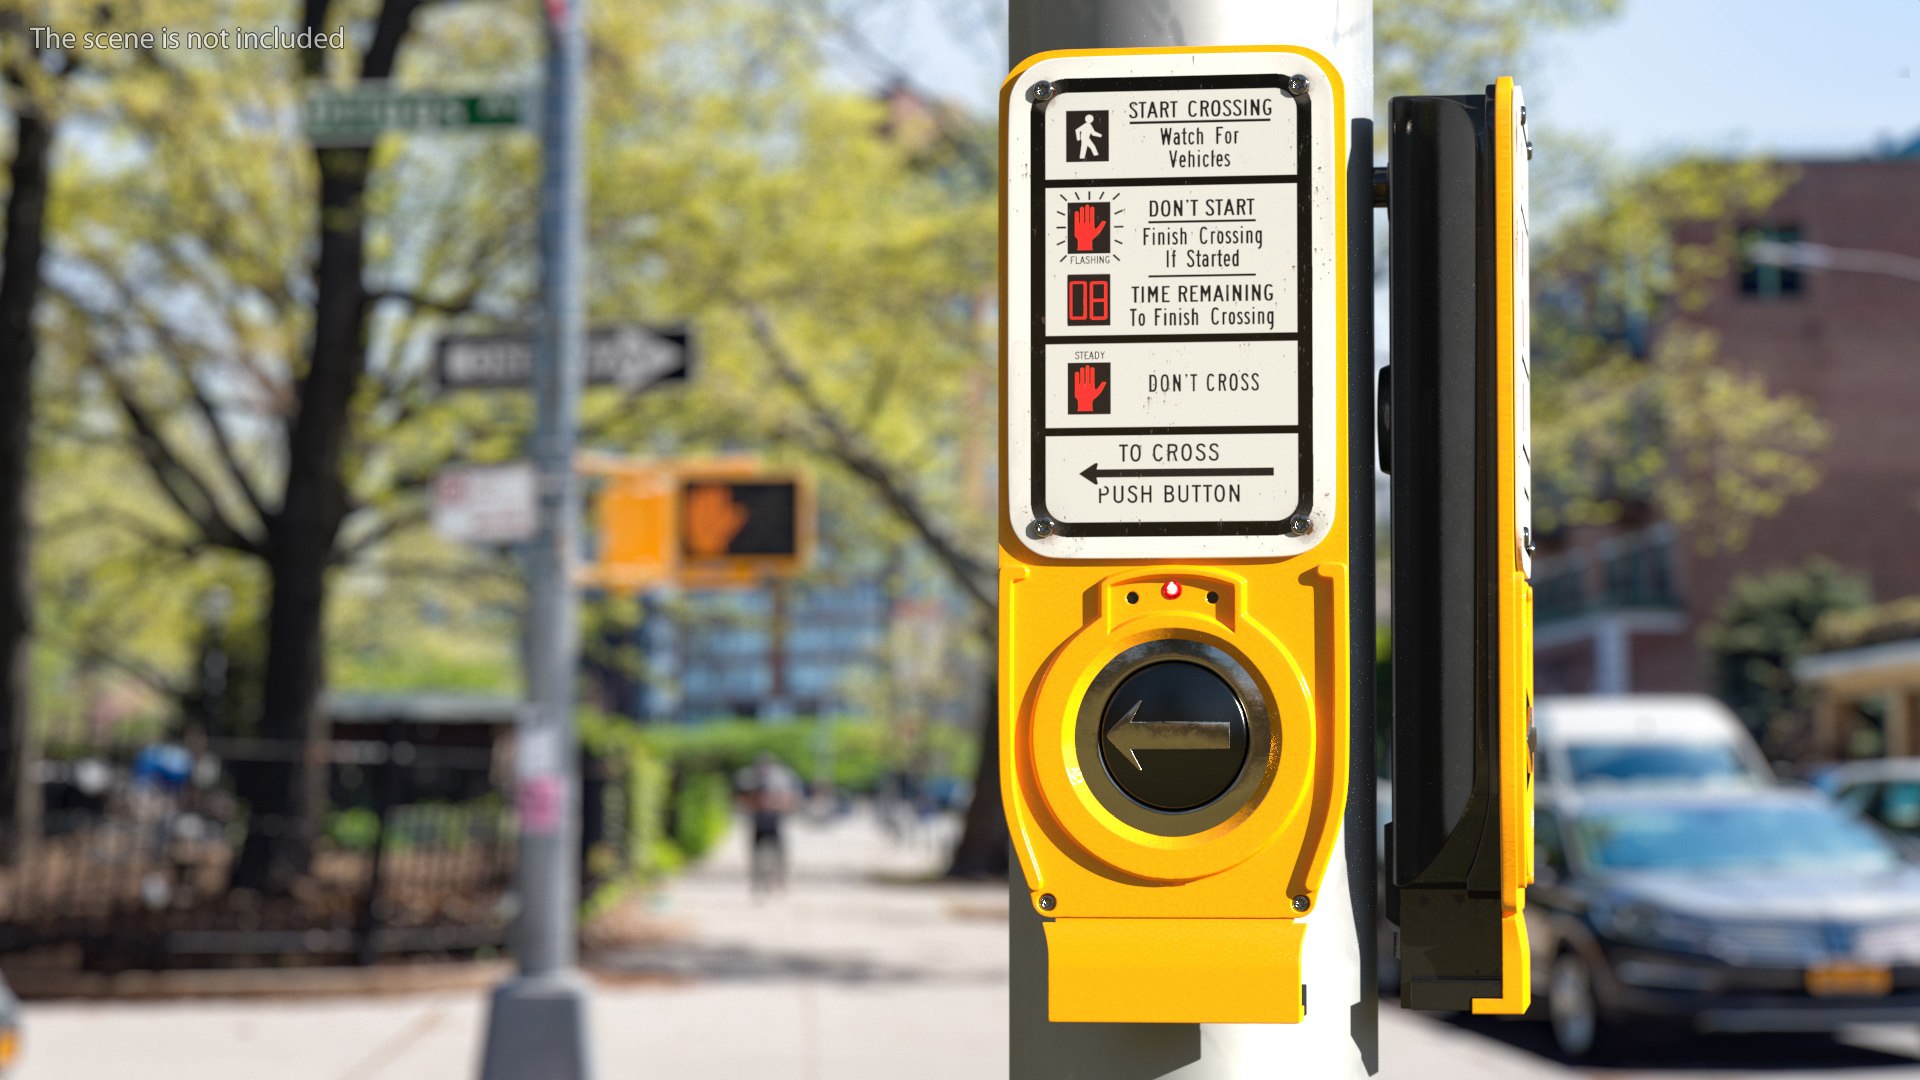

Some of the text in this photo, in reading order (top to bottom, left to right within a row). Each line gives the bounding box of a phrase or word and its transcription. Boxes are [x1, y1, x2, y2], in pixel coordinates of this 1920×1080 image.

[1129, 98, 1272, 119] START CROSSING
[1160, 126, 1239, 145] Watch For
[1169, 150, 1231, 168] Vehicles
[1149, 198, 1255, 217] DON'T START
[1143, 226, 1263, 249] Finish Crossing
[1070, 255, 1110, 265] FLASHING
[1165, 249, 1240, 268] If Started
[1068, 280, 1109, 321] 08
[1132, 283, 1274, 303] TIME REMAINING
[1130, 306, 1275, 330] To Finish Crossing
[1074, 351, 1105, 360] STEADY
[1149, 373, 1260, 392] DON'T CROSS
[1118, 443, 1220, 462] TO CROSS
[1098, 484, 1241, 504] PUSH BUTTON
